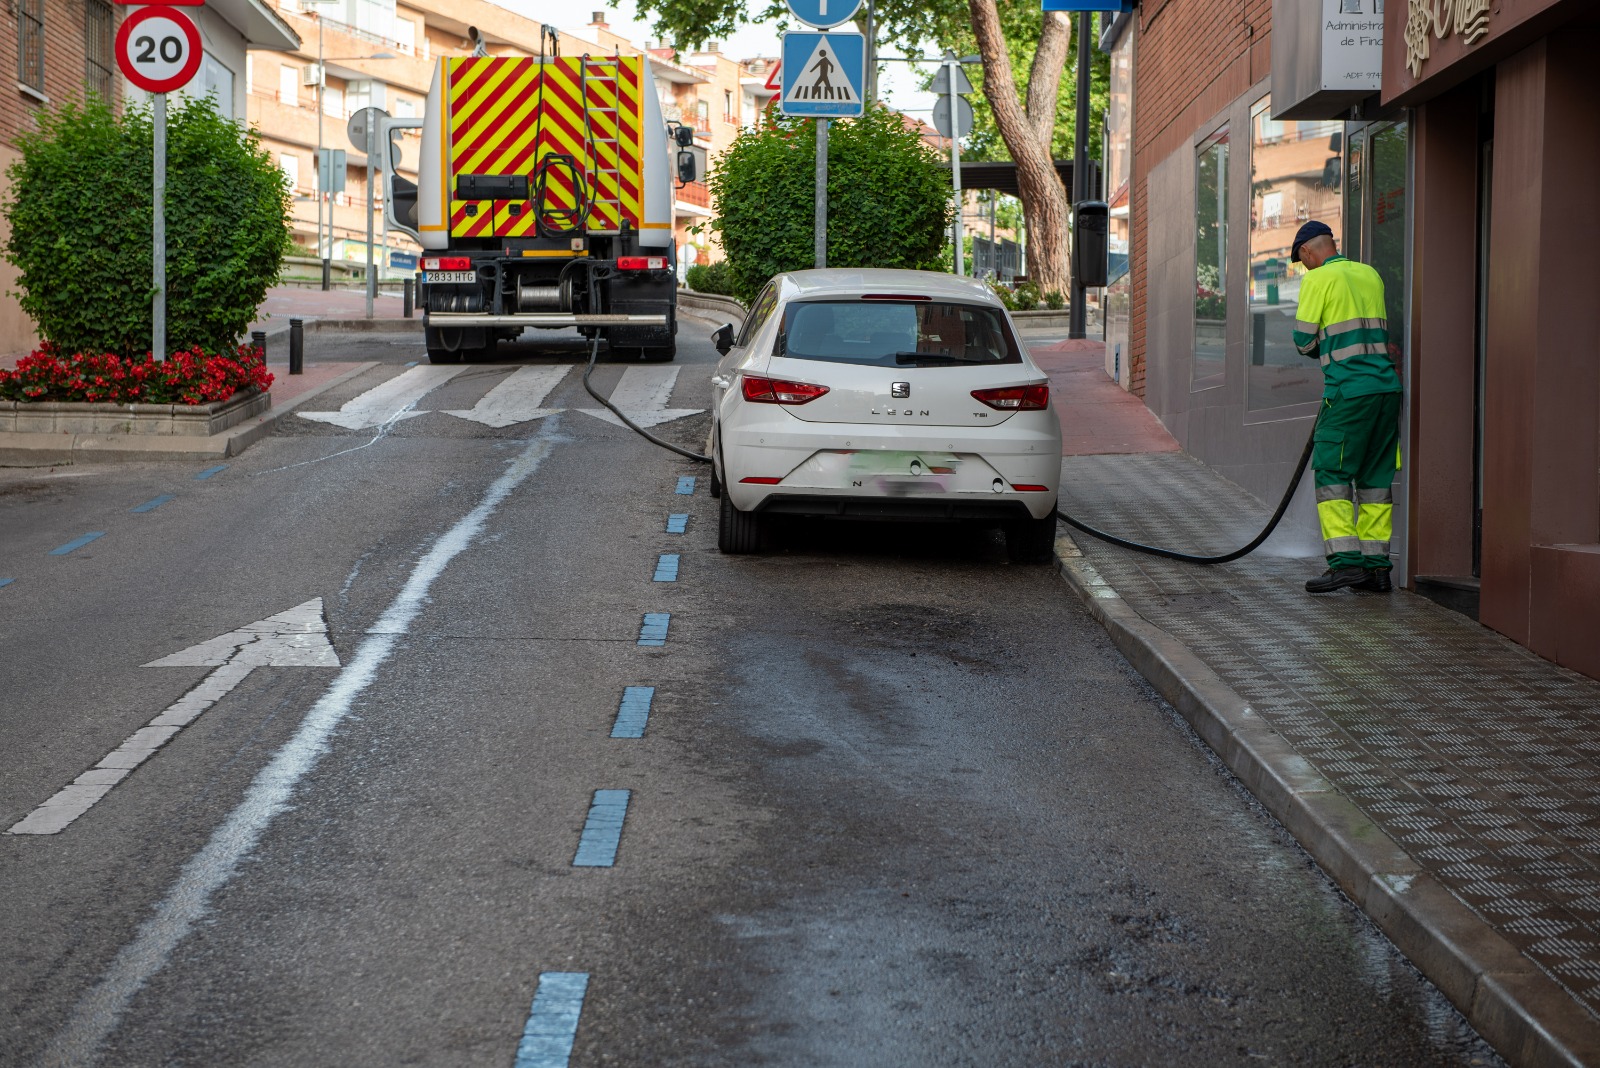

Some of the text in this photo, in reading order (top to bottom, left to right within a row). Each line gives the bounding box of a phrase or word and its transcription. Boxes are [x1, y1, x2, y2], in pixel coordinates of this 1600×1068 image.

[1340, 36, 1355, 46] de
[135, 35, 183, 64] 20
[428, 272, 473, 282] 2833 HTG
[871, 408, 930, 417] LEON
